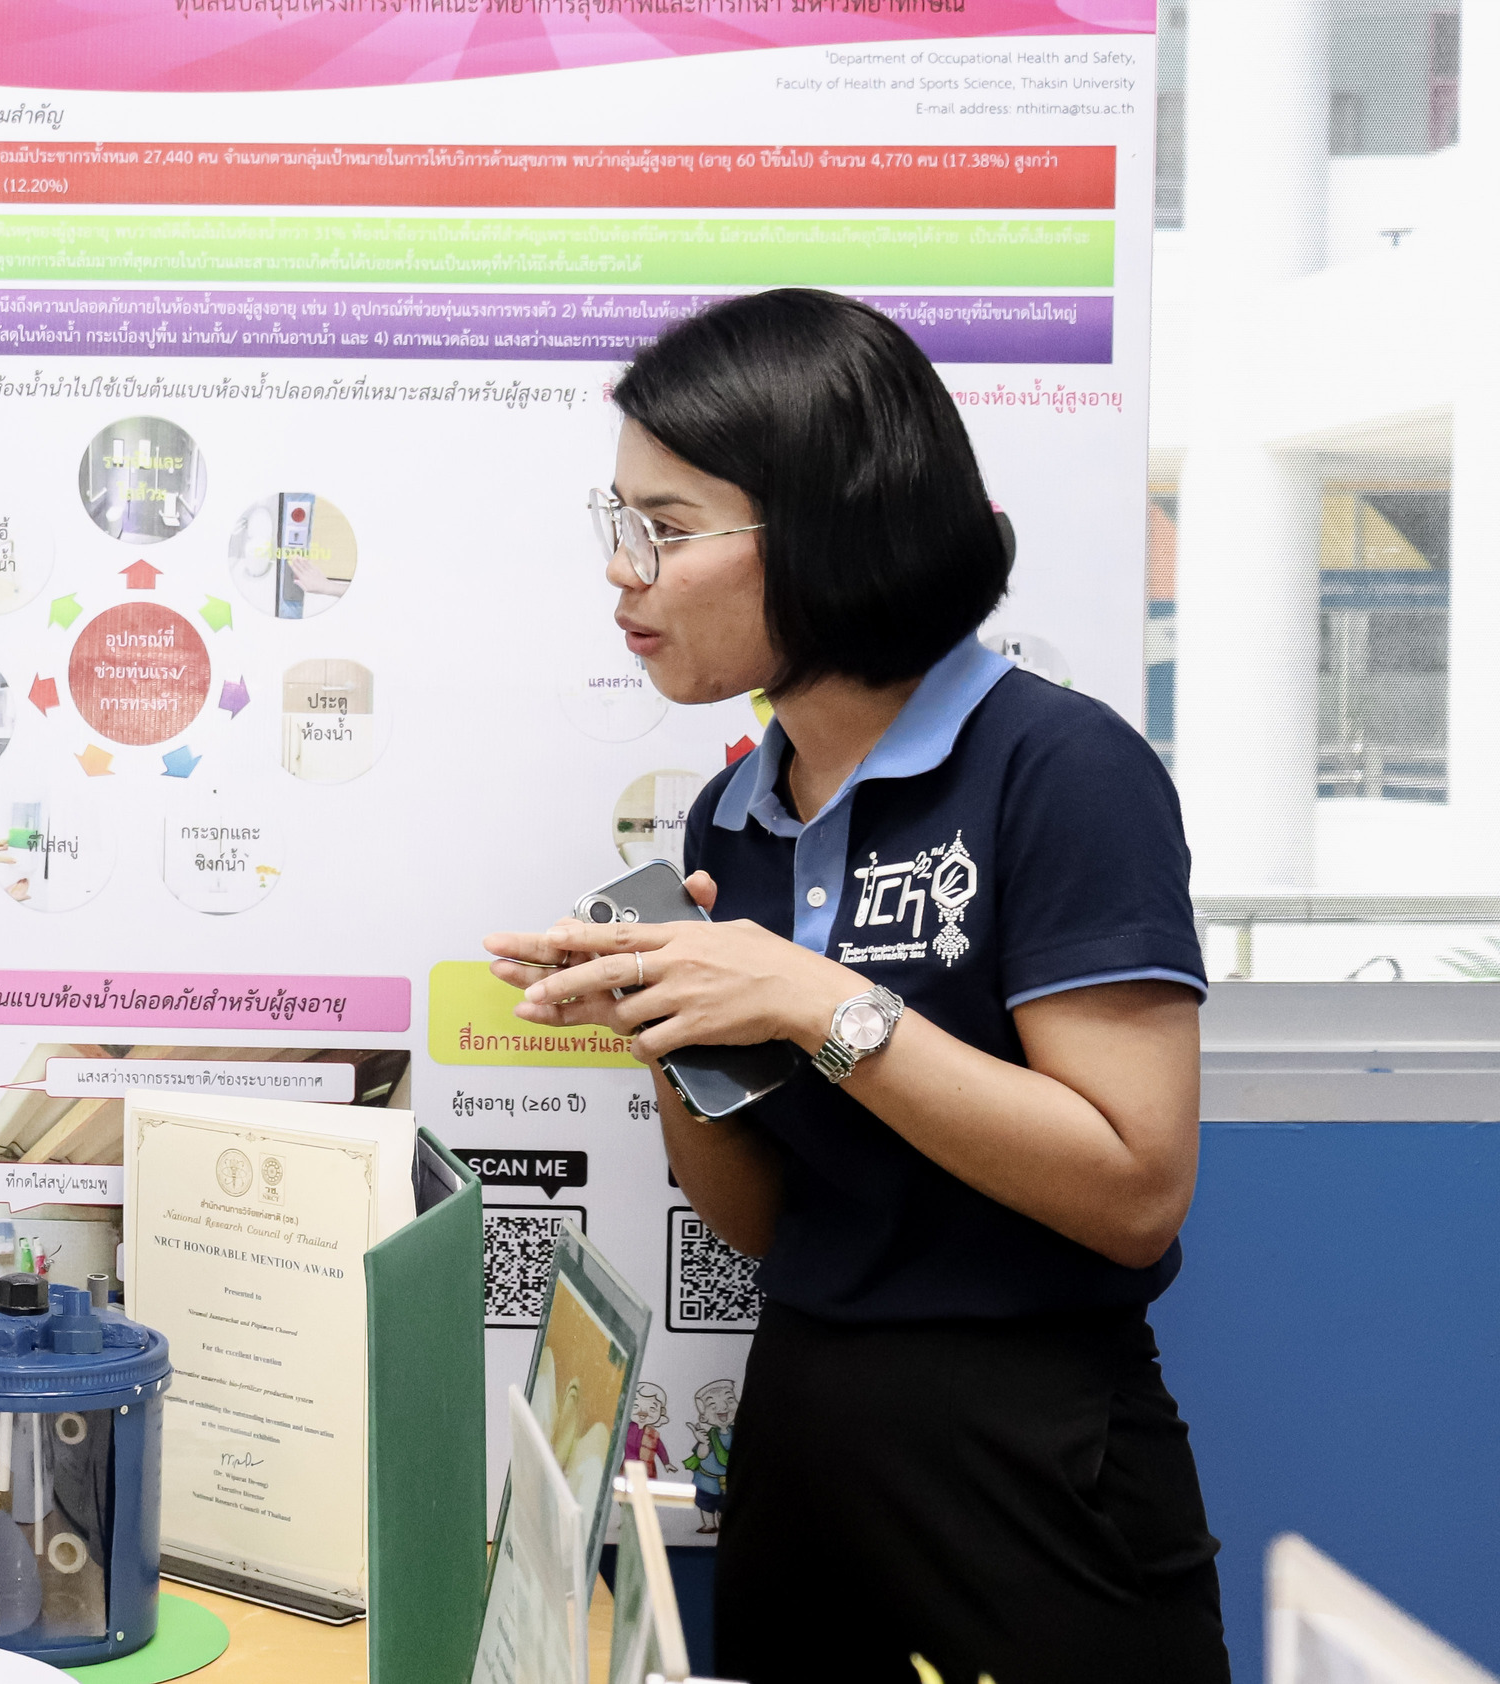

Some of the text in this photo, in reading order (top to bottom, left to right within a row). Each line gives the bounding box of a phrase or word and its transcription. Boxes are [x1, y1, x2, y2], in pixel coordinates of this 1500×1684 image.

[911, 51, 925, 64] of
[927, 51, 1012, 67] Occupational
[1017, 52, 1060, 65] Health
[1064, 52, 1088, 65] and
[1092, 51, 1136, 66] Safety,
[776, 77, 1135, 92] Faculty of Health and Sports Science, Thaksin University
[916, 102, 1135, 116] E-mail address: nthitima@tsu.ac.th
[144, 150, 193, 167] 27,440
[198, 152, 219, 165] คน
[699, 151, 732, 172] (อายุ
[736, 153, 756, 168] 60
[818, 151, 866, 169] จำนวน
[871, 153, 913, 170] 4,770
[917, 155, 939, 169] คน
[943, 152, 1010, 170] (17.38%)
[1014, 152, 1059, 173] สูงกว่า
[4, 176, 69, 193] (12.20%)
[301, 299, 327, 317] เช่น
[332, 302, 348, 318] 1)
[561, 303, 577, 319] 2)
[86, 321, 177, 349] กระเบื้องปูพื้น
[242, 322, 336, 346] ฉากกั้นอาบน้ำ
[341, 332, 369, 347] และ
[373, 331, 389, 349] 4)
[393, 327, 490, 347] สภาพแวดล้อม
[104, 625, 175, 652] อุปกรณ์ที่
[588, 672, 642, 688] แสงสว่าง
[99, 692, 179, 712] การทรงตัว
[307, 692, 348, 715] ประตู
[301, 716, 353, 742] ห้องน้ำ
[181, 826, 260, 840] กระจกและ
[195, 848, 245, 872] ซิงก์น้ำ
[76, 1068, 323, 1088] แสงสว่างจากธรรมชาติ/ช่องระบายอากาศ
[452, 1090, 516, 1117] ผู้สูงอายุ
[567, 1092, 587, 1114] ปี)
[467, 1158, 568, 1177] SCAN ME
[6, 1170, 108, 1198] ที่กดใส่สบู่/แชมพู
[163, 1208, 339, 1250] National Research Council of Thailand
[154, 1235, 344, 1280] NRCT HONORABLE MENTION AWARD
[224, 1287, 262, 1301] Presented to
[202, 1342, 282, 1367] For the excellent invention
